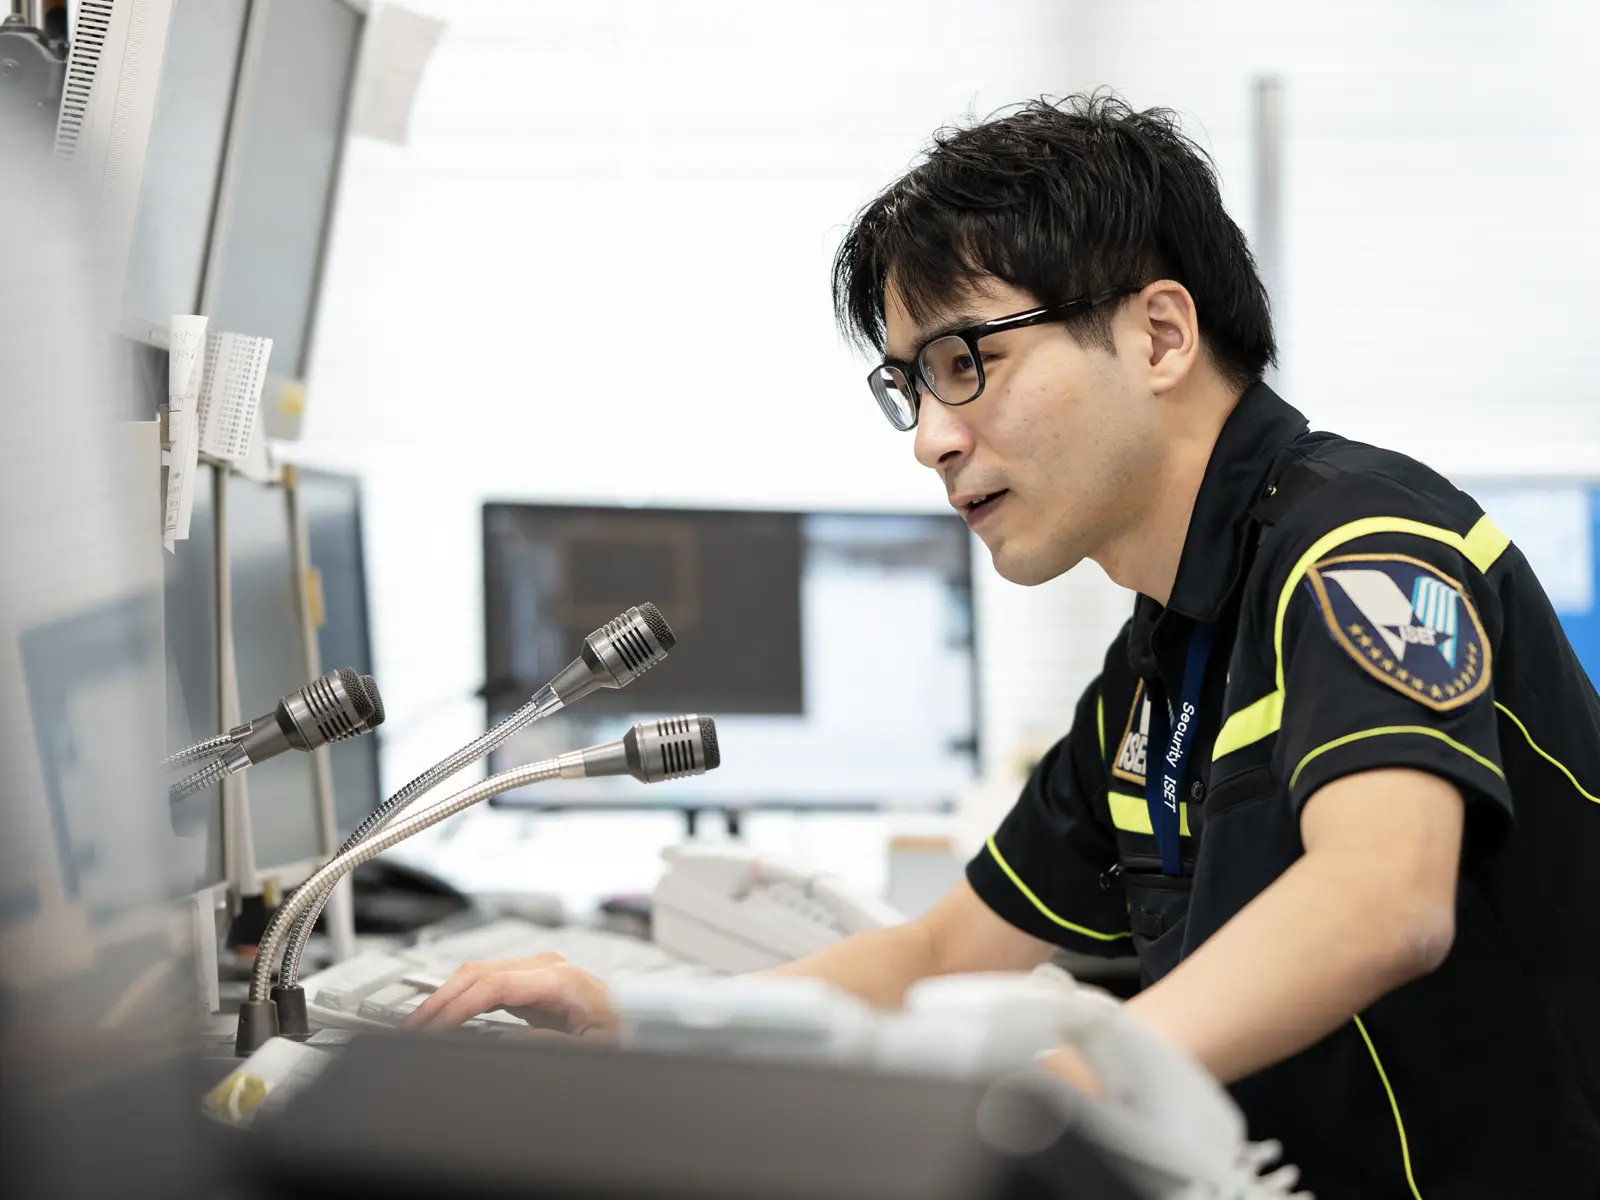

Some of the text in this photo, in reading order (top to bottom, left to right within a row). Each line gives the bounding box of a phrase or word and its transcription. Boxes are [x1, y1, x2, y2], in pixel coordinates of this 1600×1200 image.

[1117, 732, 1148, 775] ISE
[1163, 701, 1195, 814] Security ISET
